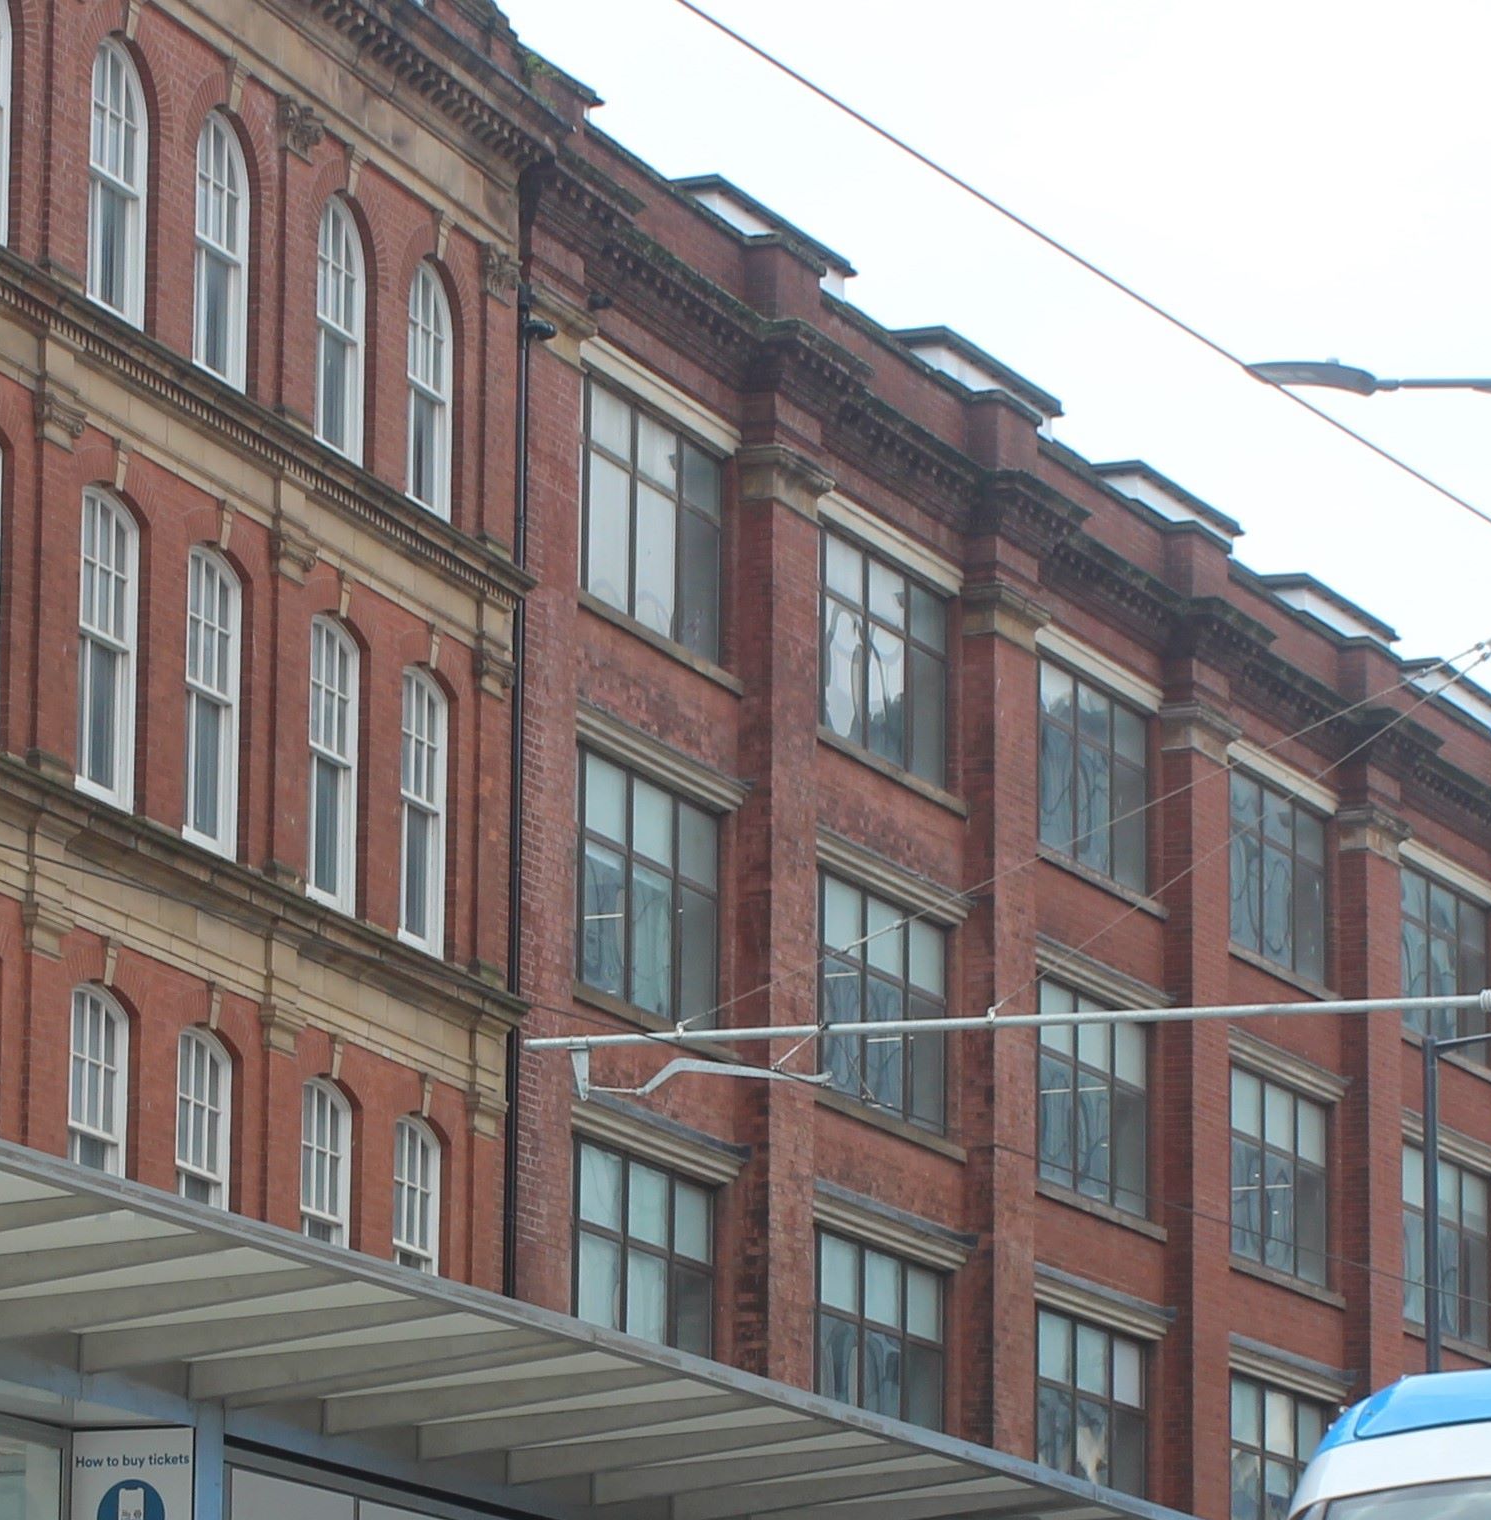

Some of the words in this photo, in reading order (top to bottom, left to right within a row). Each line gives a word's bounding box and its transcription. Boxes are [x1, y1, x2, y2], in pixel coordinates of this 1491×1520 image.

[75, 1456, 103, 1468] How
[107, 1456, 119, 1467] to
[122, 1454, 145, 1468] buy
[149, 1453, 190, 1466] tickets
